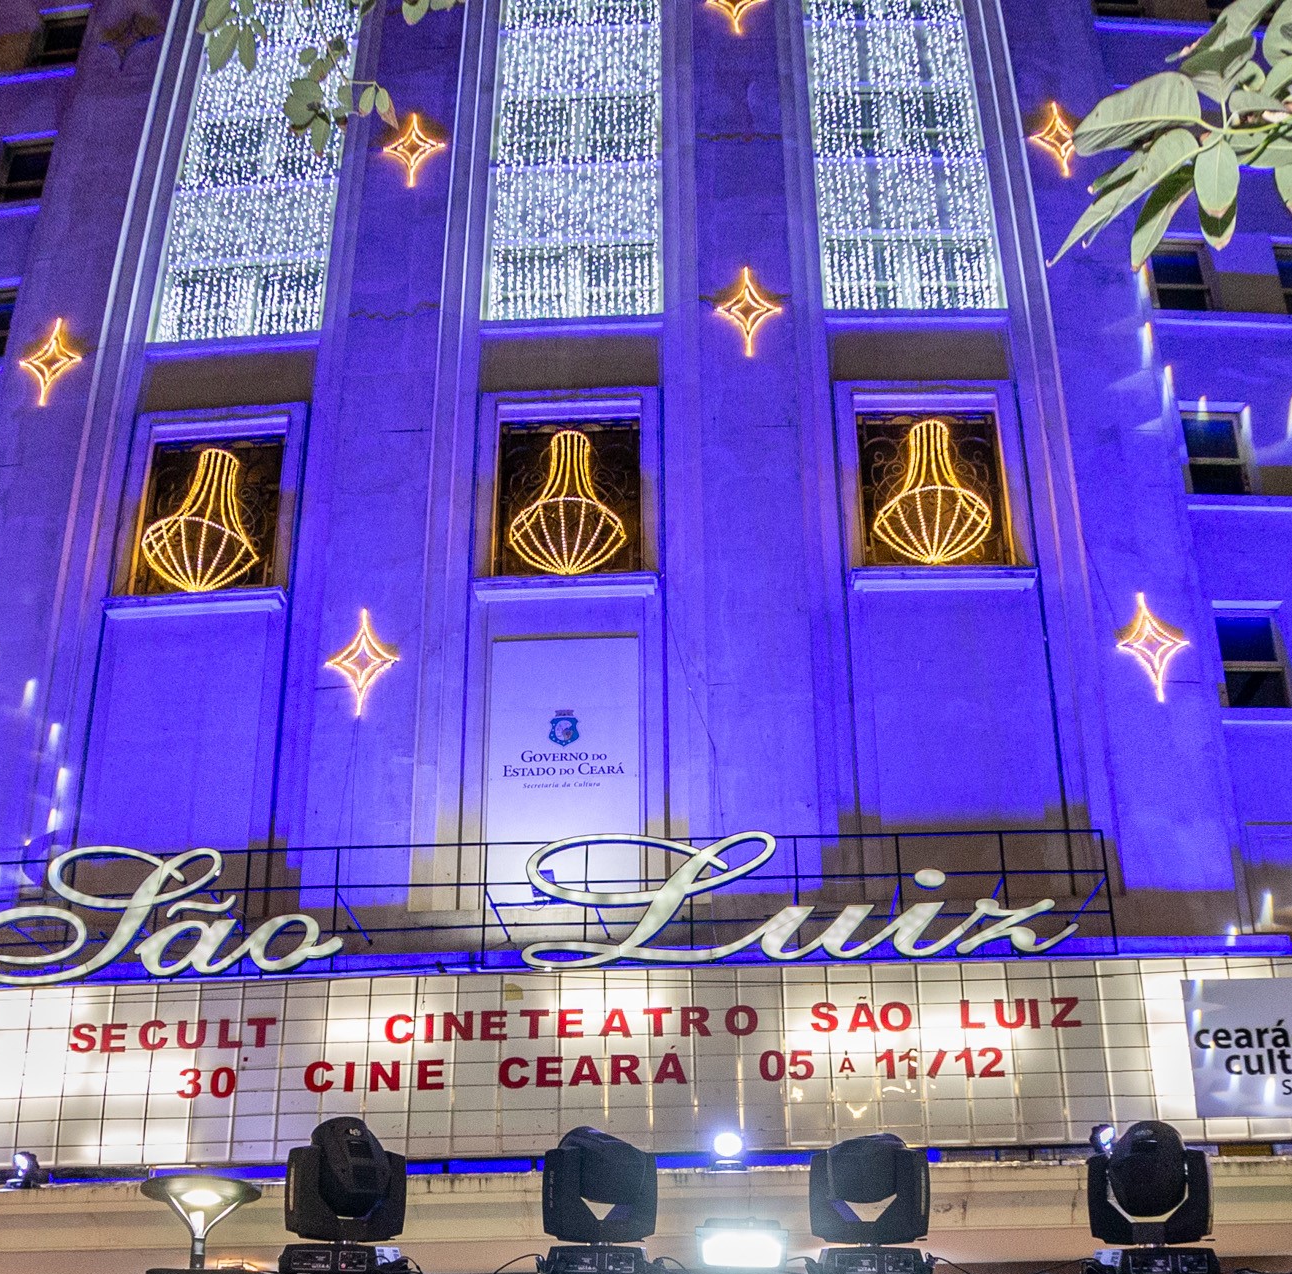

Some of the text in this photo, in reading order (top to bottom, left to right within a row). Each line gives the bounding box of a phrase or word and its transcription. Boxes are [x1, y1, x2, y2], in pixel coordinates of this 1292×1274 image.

[502, 761, 625, 778] ESTADO DO CEARÁ
[520, 750, 607, 763] GOVERNO DO
[574, 780, 601, 788] Cultura
[521, 830, 1080, 969] Luiz
[69, 996, 1082, 1054] SECULT CINETEATRO SÃO LUIZ
[1193, 1018, 1292, 1049] ceará
[304, 1058, 445, 1092] CINE
[498, 1044, 687, 1089] CEARÁ
[759, 1050, 814, 1081] 05
[875, 1047, 1006, 1080] 11/12
